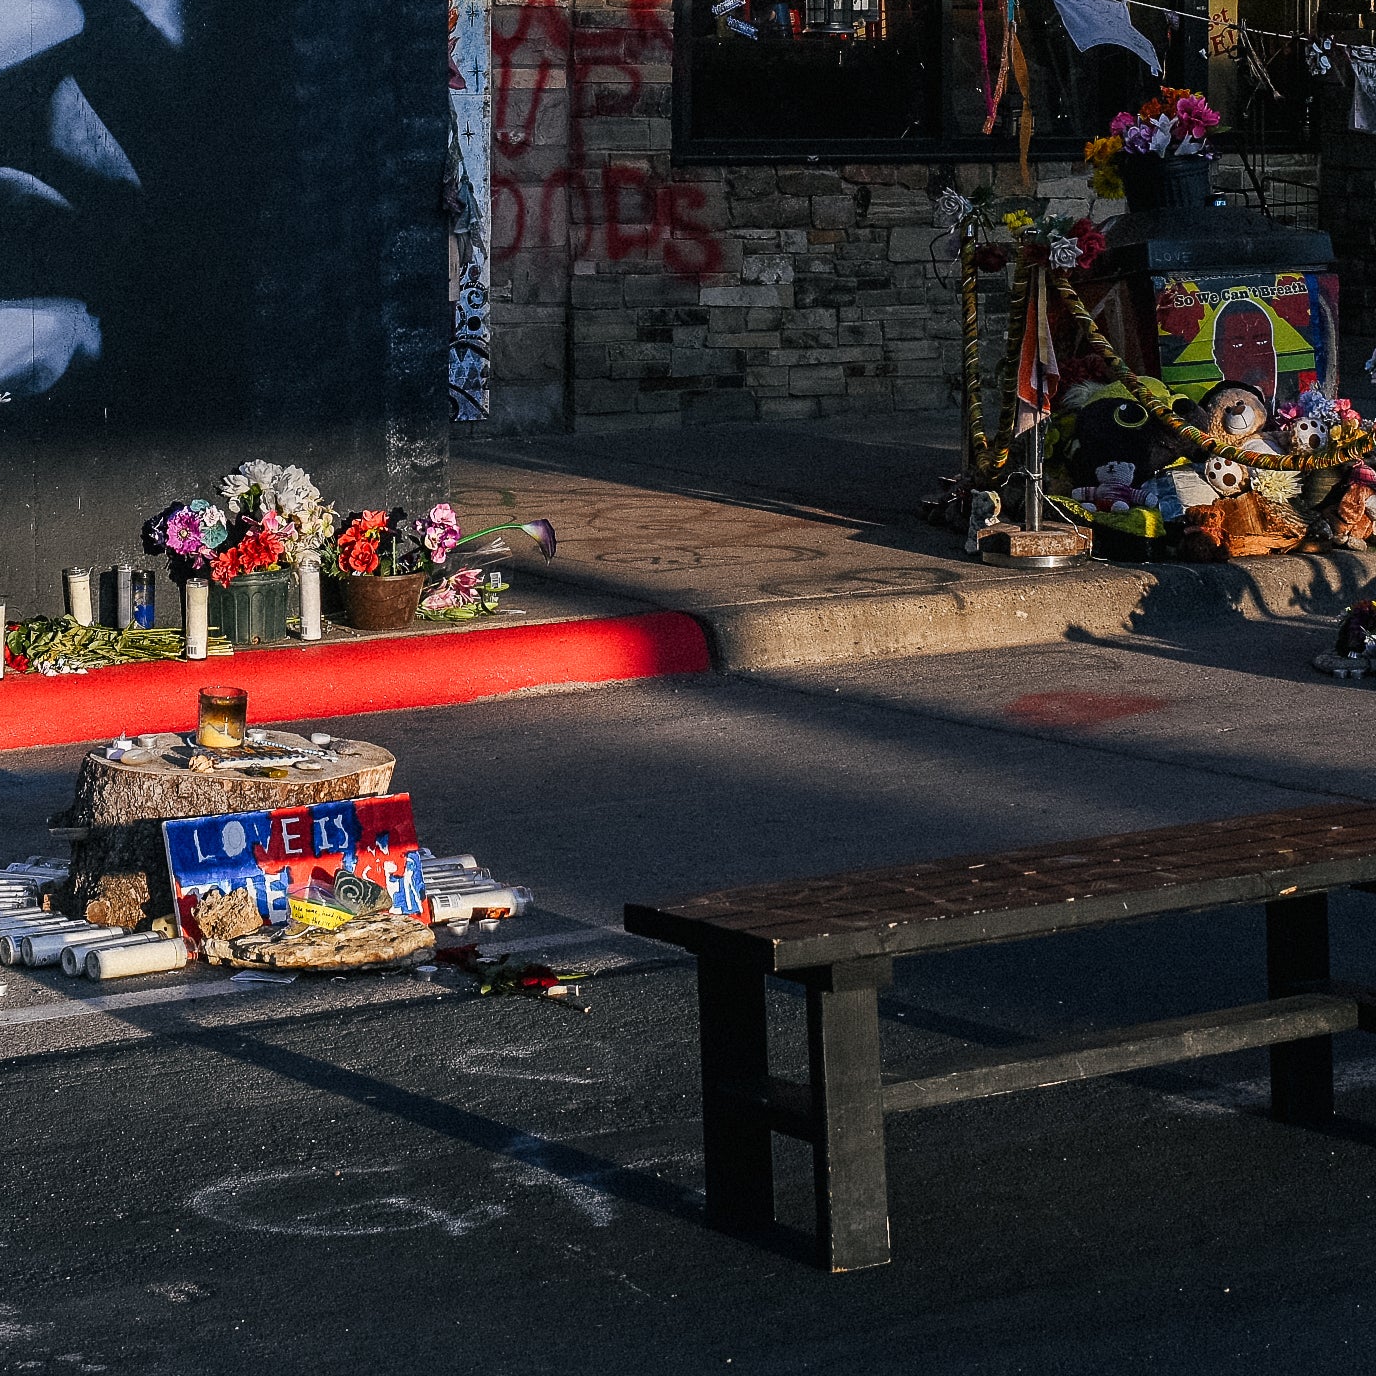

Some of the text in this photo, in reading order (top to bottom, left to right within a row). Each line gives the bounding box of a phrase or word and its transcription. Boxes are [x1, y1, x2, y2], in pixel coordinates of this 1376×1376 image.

[1174, 280, 1309, 308] So We Can't Breath
[193, 814, 351, 864] LOVE IS
